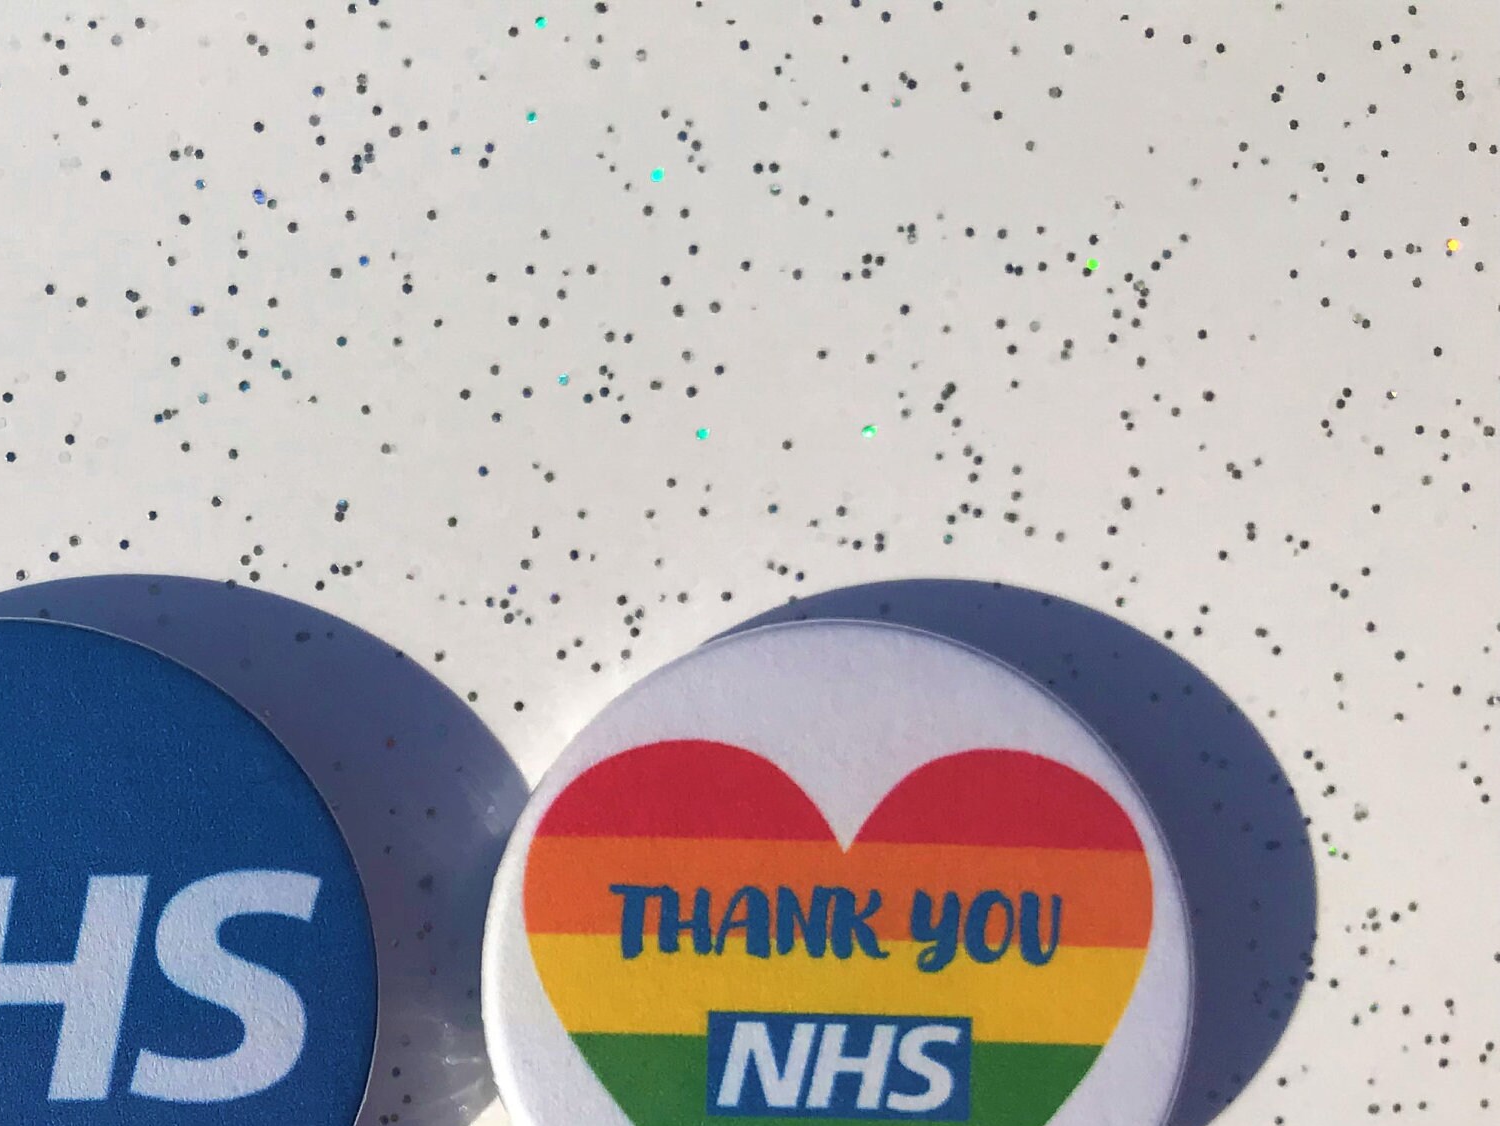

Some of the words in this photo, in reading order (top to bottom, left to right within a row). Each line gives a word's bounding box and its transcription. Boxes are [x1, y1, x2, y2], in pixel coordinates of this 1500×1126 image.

[609, 884, 889, 960] THANK
[909, 889, 1063, 973] YOU
[717, 1020, 955, 1110] NHS
